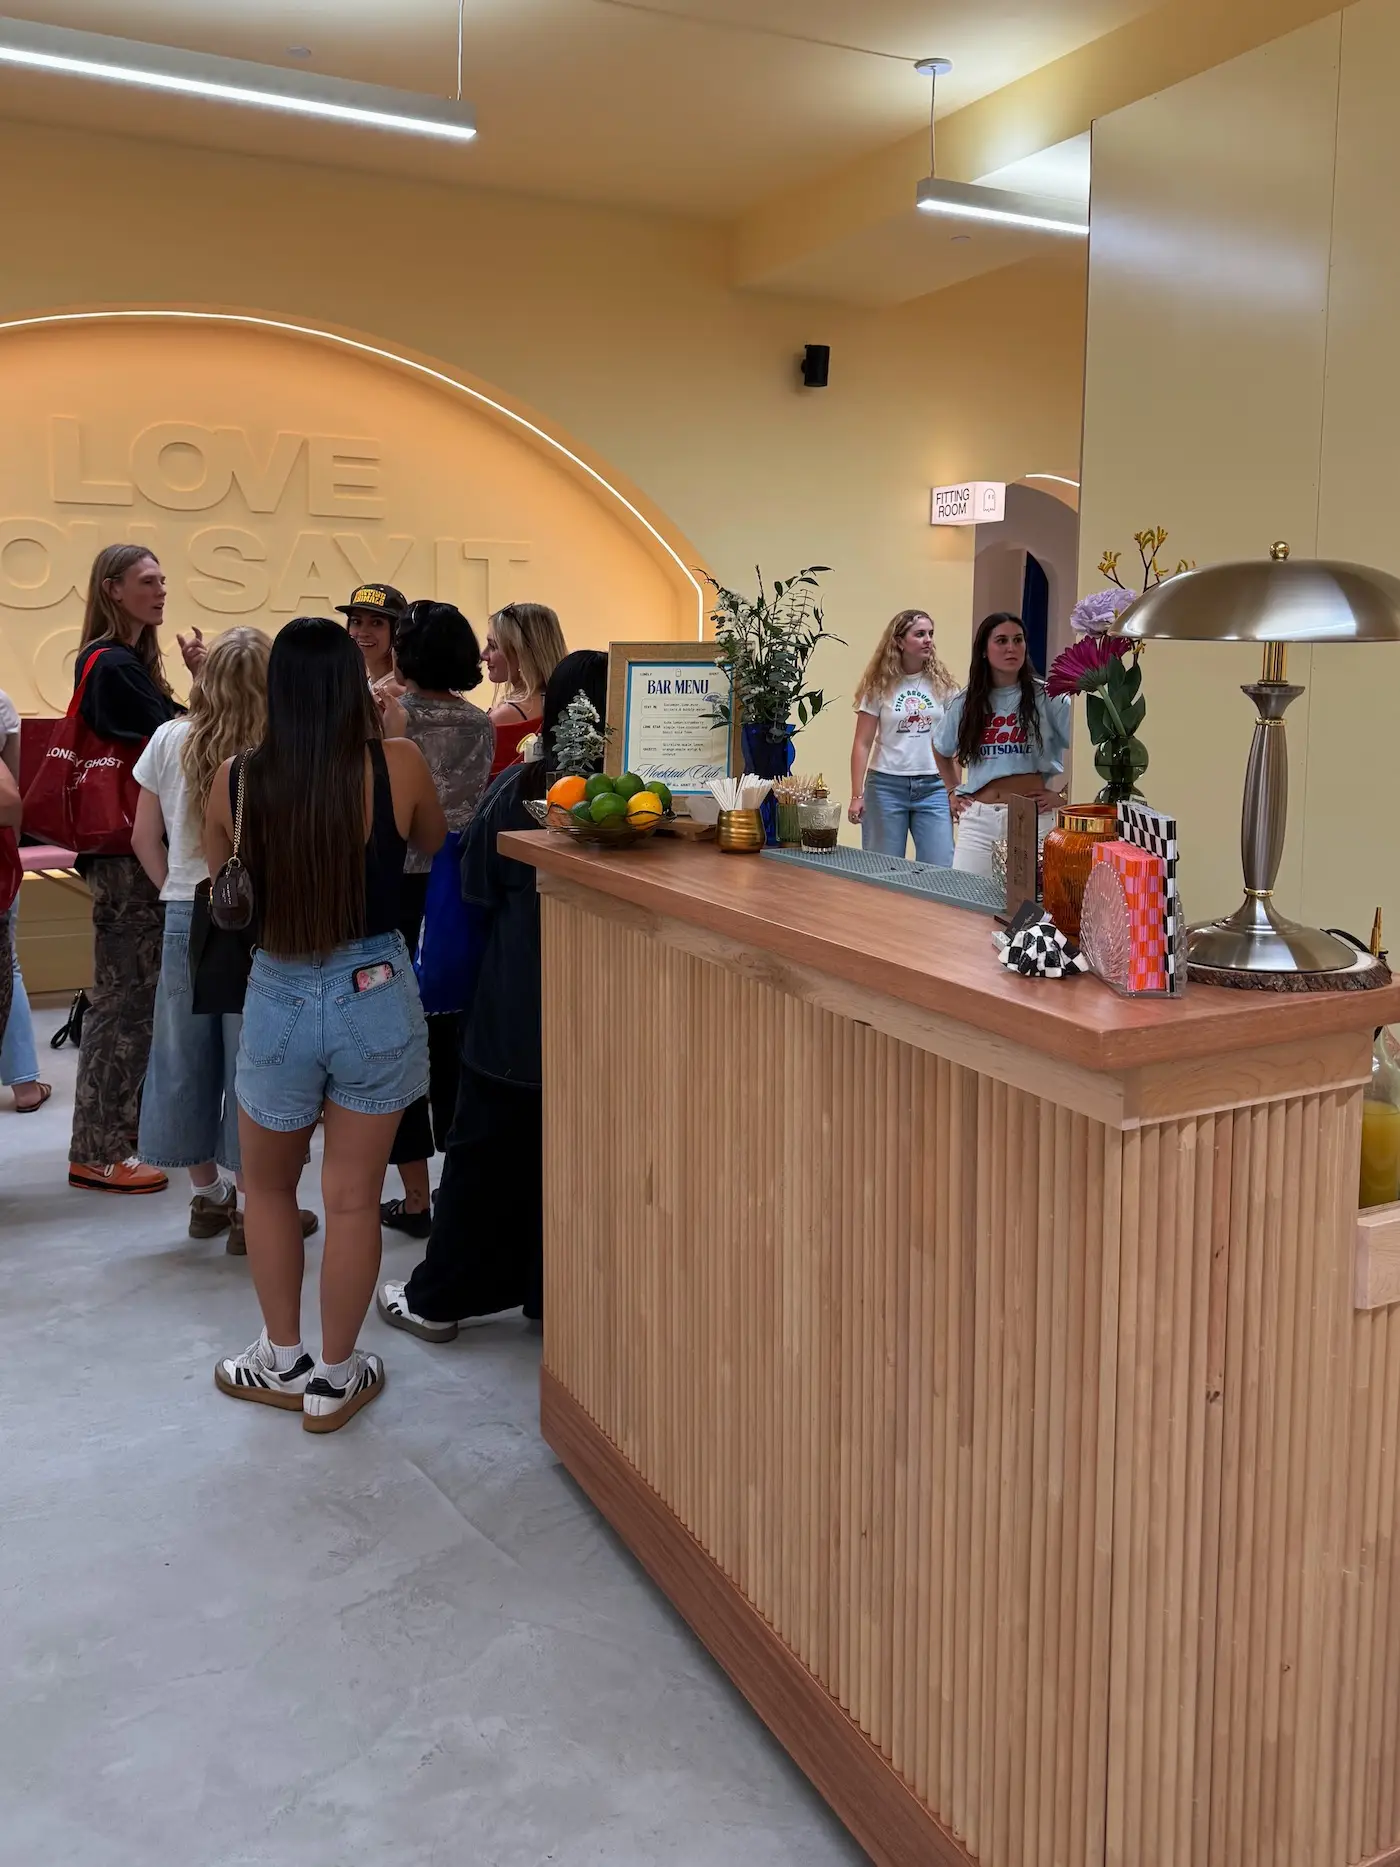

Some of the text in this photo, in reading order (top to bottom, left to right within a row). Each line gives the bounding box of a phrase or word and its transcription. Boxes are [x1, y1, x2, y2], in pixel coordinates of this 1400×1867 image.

[51, 414, 384, 519] LOVE
[936, 488, 970, 505] FITTING
[938, 502, 967, 518] ROOM
[186, 525, 415, 617] SAY
[433, 537, 532, 617] IT
[647, 679, 709, 695] BAR MENU
[46, 747, 124, 769] LONEY GHOST
[979, 744, 1035, 756] OTTSDALE
[632, 763, 723, 780] Mocktail Club
